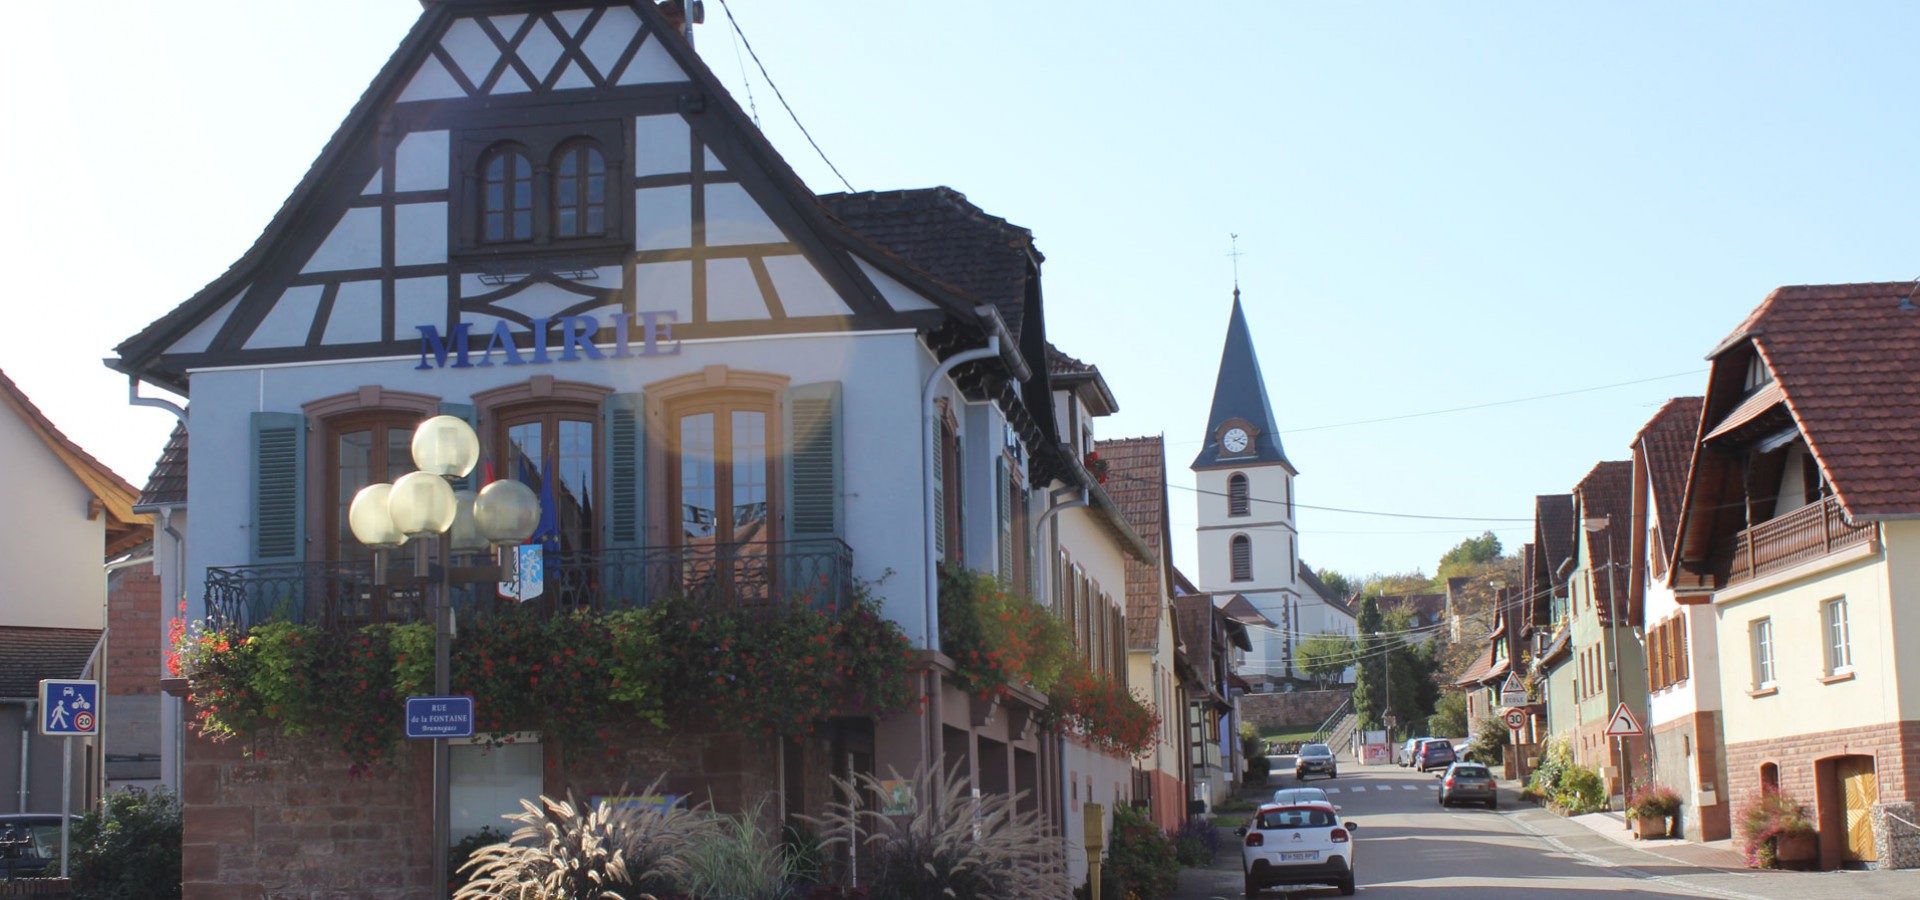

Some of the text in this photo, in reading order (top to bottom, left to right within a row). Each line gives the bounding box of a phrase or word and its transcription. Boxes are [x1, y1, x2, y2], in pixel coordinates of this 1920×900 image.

[414, 310, 681, 371] MAIRIE
[79, 717, 90, 725] 20
[429, 714, 468, 722] FONTAINE
[1510, 714, 1522, 724] 30
